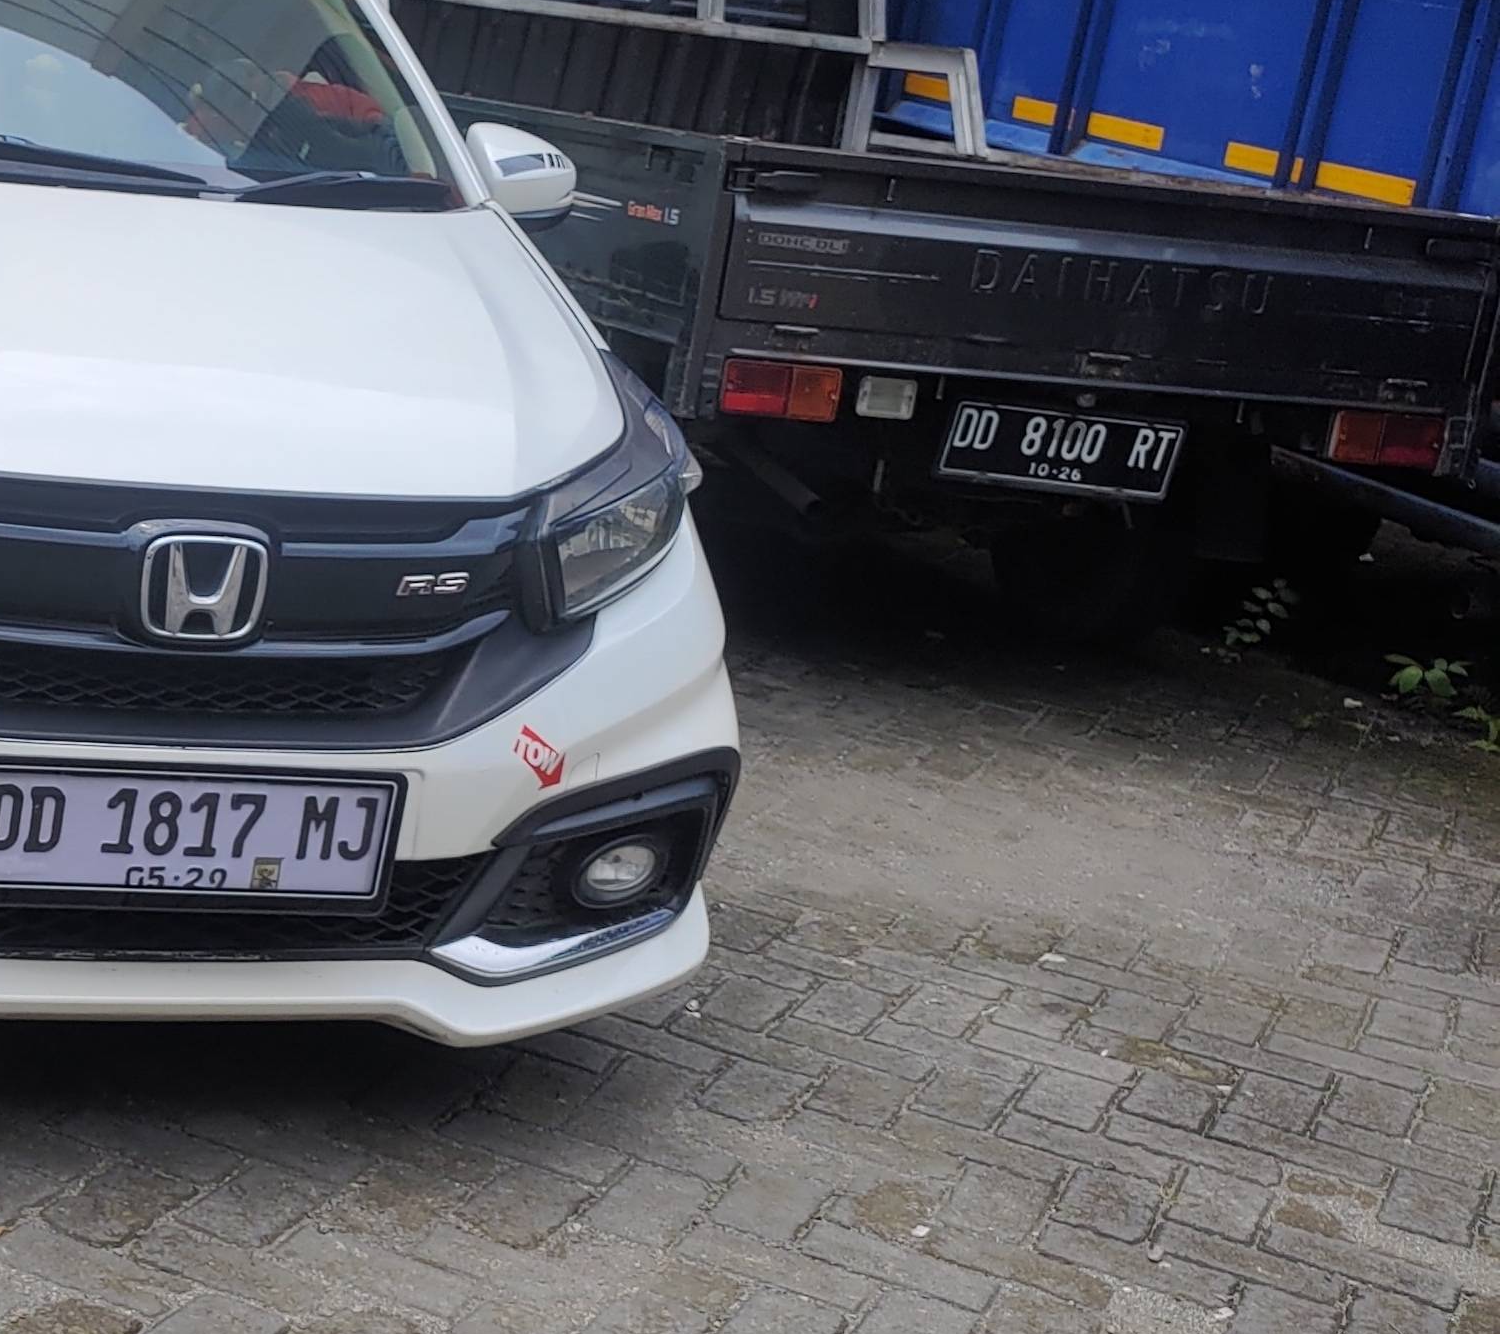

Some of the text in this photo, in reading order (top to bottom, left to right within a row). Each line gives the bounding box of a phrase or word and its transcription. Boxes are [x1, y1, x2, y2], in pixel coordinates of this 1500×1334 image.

[970, 248, 1276, 315] DAIHATSU
[952, 407, 1177, 472] DD 8100 RT
[396, 571, 470, 596] RS
[512, 733, 562, 775] TOW
[99, 786, 268, 859] 1817
[295, 795, 380, 861] MJ
